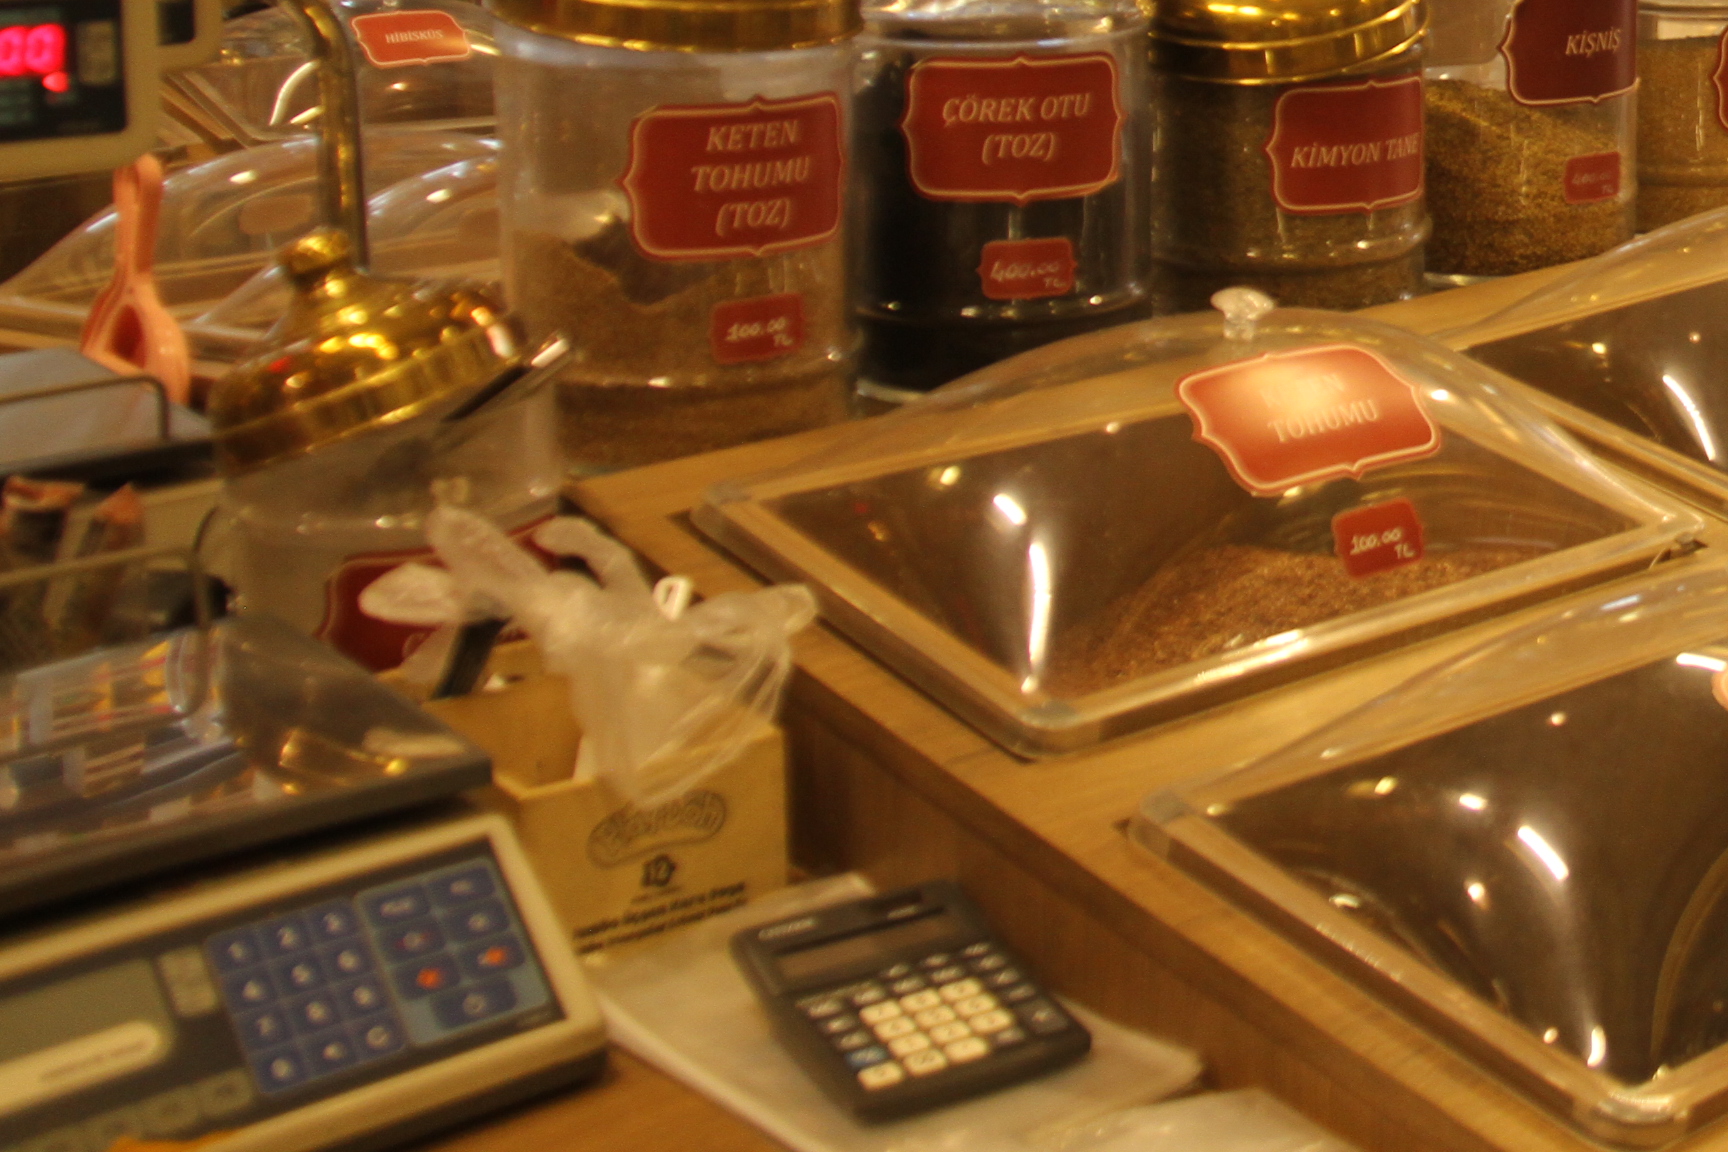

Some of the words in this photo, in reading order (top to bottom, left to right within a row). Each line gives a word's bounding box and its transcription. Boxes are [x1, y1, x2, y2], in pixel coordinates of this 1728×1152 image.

[1565, 25, 1622, 59] KİŞNİŞ
[942, 94, 1036, 129] ÇÖREK
[1040, 91, 1093, 121] OTU
[706, 119, 800, 152] KETEN
[981, 131, 1058, 165] (TOZ)
[1290, 141, 1383, 169] KİMYON
[691, 156, 811, 192] TOHUMU
[715, 196, 792, 237] (TOZ)
[1258, 371, 1346, 409] KEN
[1266, 399, 1380, 443] TOHUMU
[1394, 545, 1415, 559] TL
